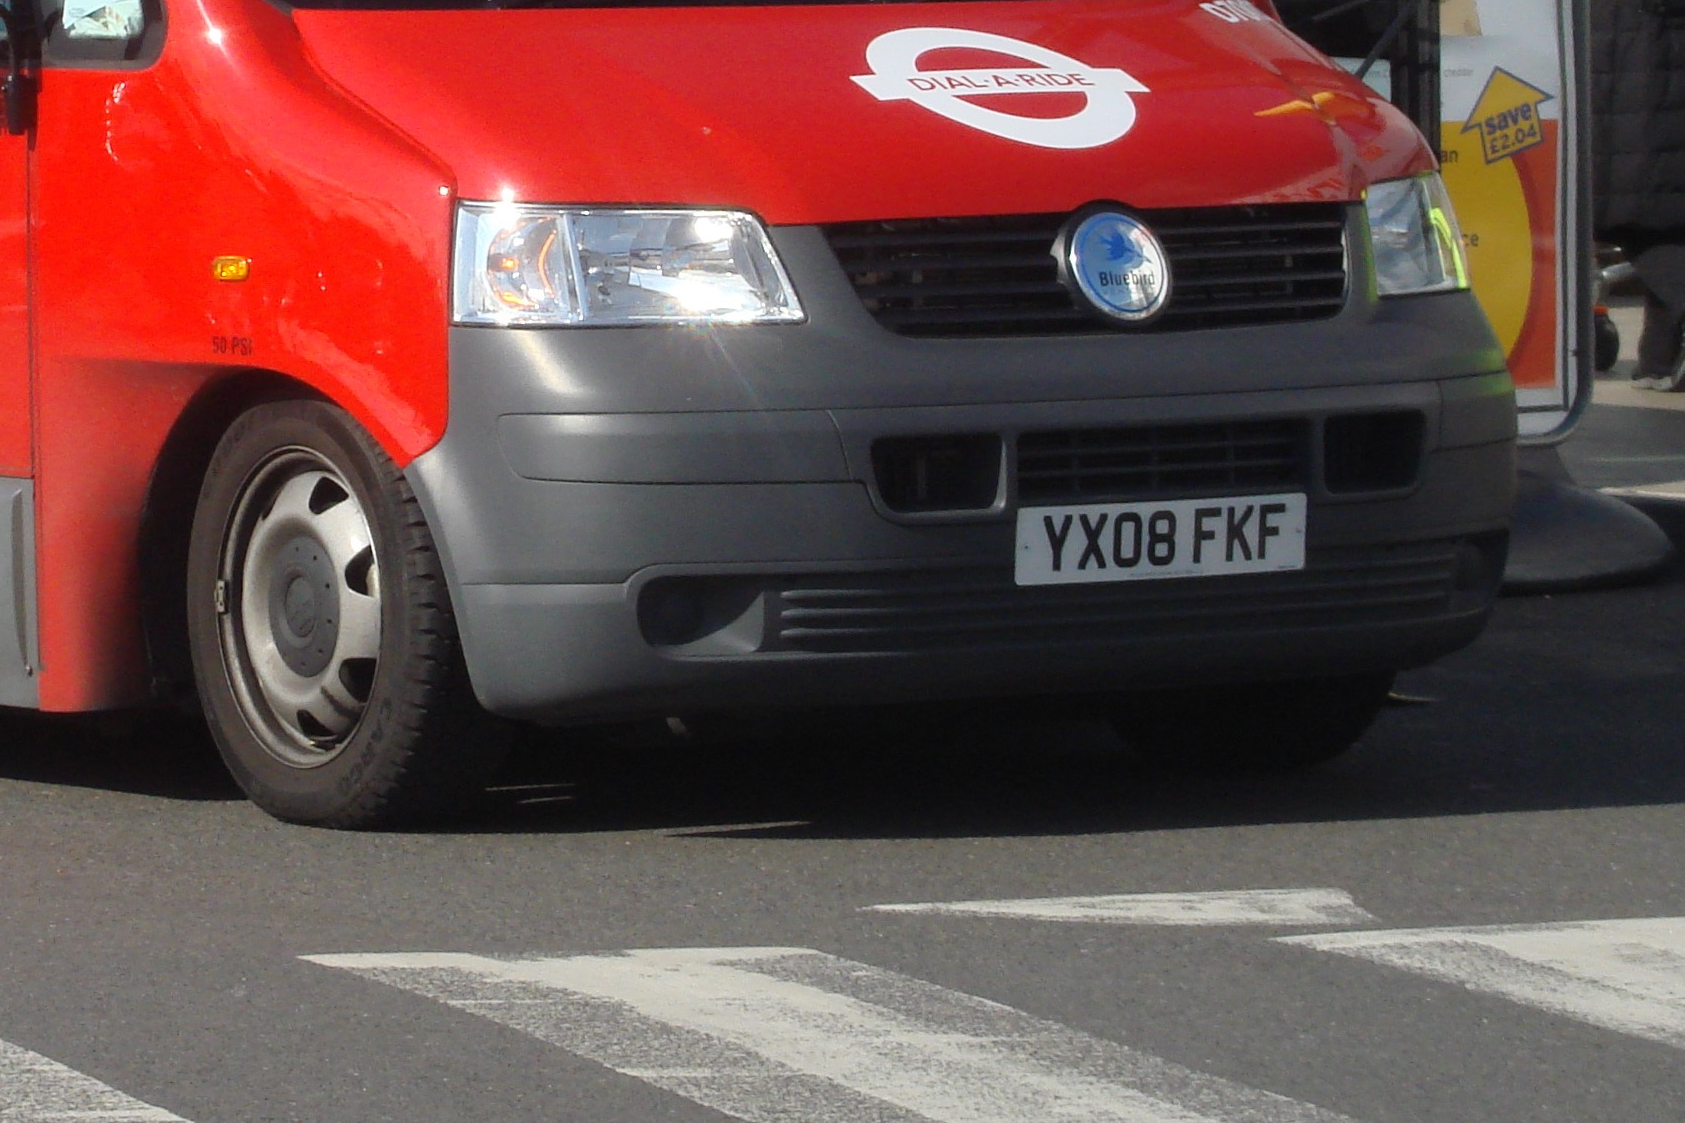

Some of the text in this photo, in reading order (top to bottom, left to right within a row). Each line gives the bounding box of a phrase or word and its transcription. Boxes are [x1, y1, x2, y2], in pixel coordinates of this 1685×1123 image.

[1484, 102, 1532, 136] save
[1489, 124, 1537, 155] £2.04
[1441, 150, 1459, 163] an
[1462, 232, 1479, 247] ce
[1099, 270, 1155, 286] Bluebird
[231, 336, 252, 356] PSI
[1043, 503, 1287, 572] YX08 FKF
